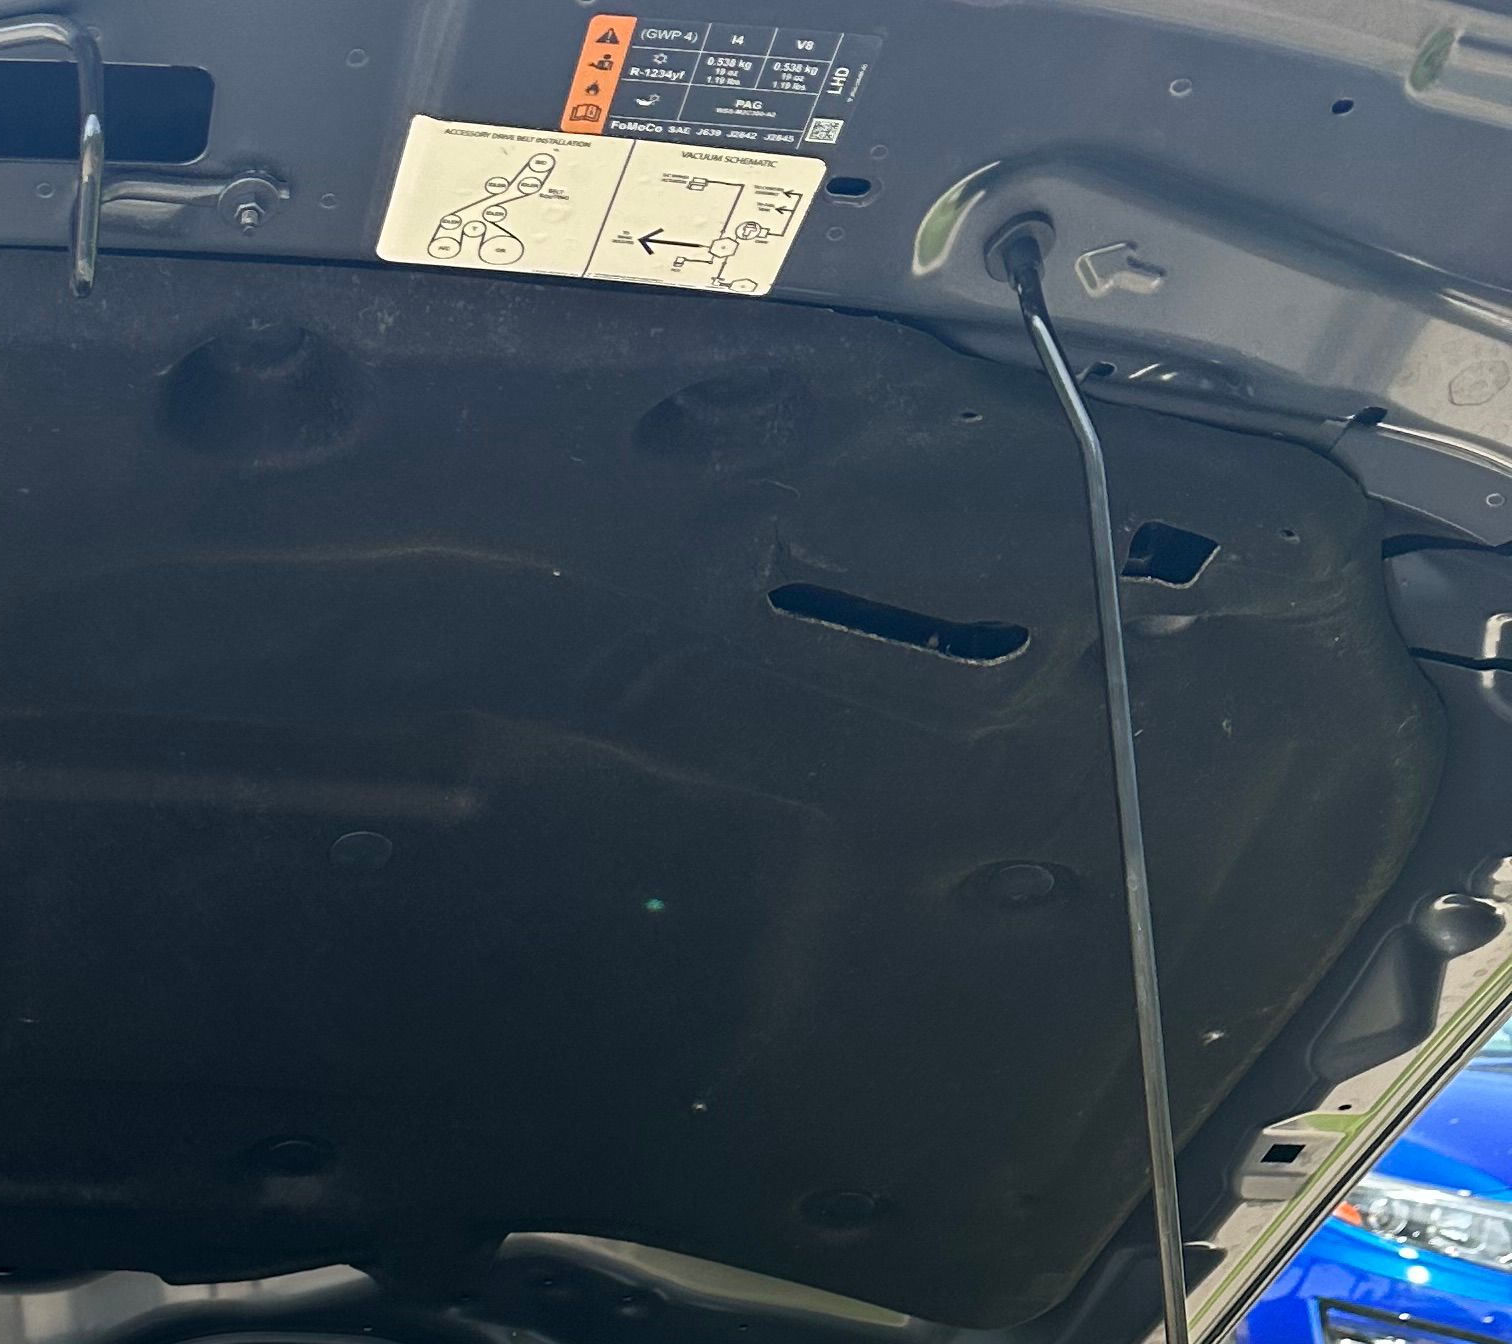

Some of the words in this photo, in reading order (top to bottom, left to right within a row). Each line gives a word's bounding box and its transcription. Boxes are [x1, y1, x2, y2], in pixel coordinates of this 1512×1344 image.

[640, 28, 682, 42] (GWP
[684, 31, 698, 43] 4)
[796, 39, 815, 51] V8
[706, 56, 737, 68] 0.538
[738, 58, 753, 71] kg
[772, 61, 802, 73] 0.538
[804, 64, 819, 76] kg
[629, 66, 686, 81] R-1234yf
[826, 66, 850, 96] LHD
[735, 99, 763, 110] PAG
[444, 127, 492, 139] ACCESSORY
[610, 119, 663, 133] FoMoCo
[667, 125, 692, 135] SAE
[681, 150, 723, 163] VACUUM
[724, 155, 779, 169] SCHEMATIC
